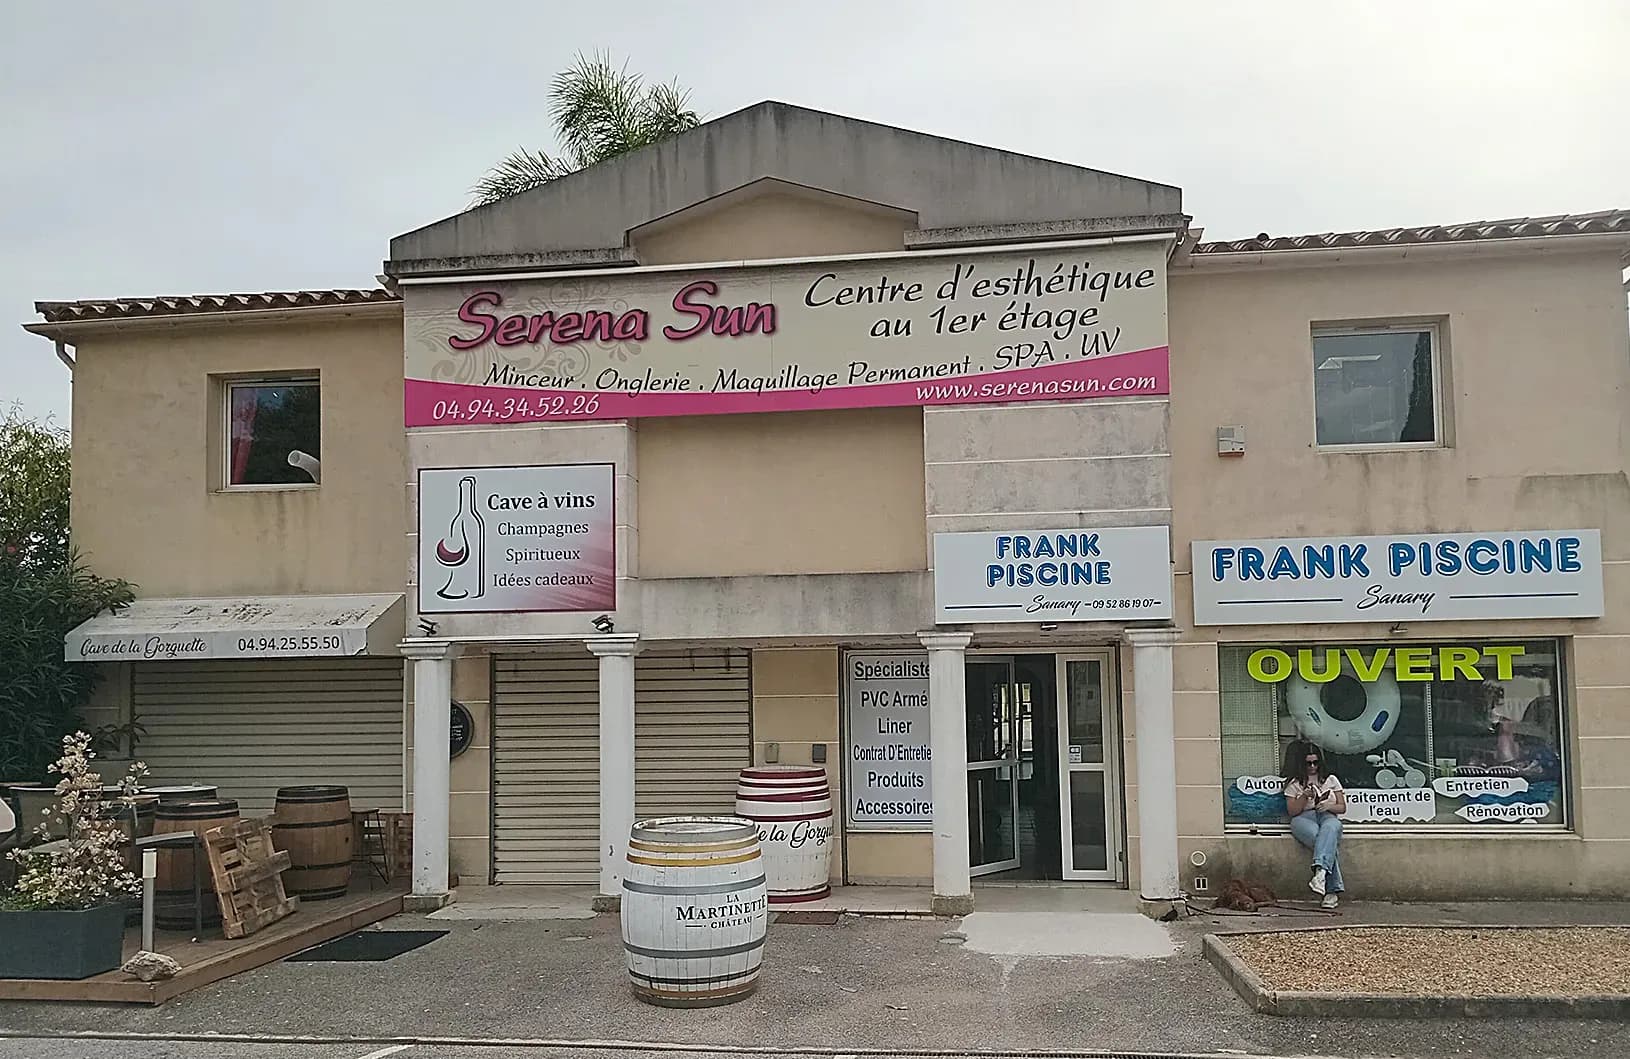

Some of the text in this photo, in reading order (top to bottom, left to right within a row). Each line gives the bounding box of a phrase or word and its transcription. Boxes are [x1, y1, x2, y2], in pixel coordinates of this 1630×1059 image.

[804, 259, 1155, 308] Centre d'esthétique
[448, 281, 777, 350] Serena Sun
[870, 301, 1100, 339] au 1er étage
[483, 363, 575, 389] Minceur
[596, 367, 690, 398] Onglerie
[711, 365, 838, 396] Maquillage
[847, 355, 972, 386] Permanent
[994, 341, 1056, 371] SPA
[1081, 326, 1122, 357] UV
[915, 375, 1157, 401] www.serenasun.com
[432, 395, 600, 420] 04.94.34.52.26
[488, 492, 596, 511] Cave à vins
[498, 522, 589, 538] Champagnes
[996, 533, 1101, 560] FRANK
[506, 549, 581, 565] Spiritueux
[1212, 537, 1582, 582] FRANK PISCINE
[493, 573, 594, 587] Idées cadeaux
[987, 561, 1111, 587] PISCINE
[1026, 594, 1082, 616] Sanary
[1106, 600, 1117, 608] 52
[1119, 600, 1130, 608] 86
[1132, 599, 1141, 608] 19
[1357, 585, 1436, 613] Sanary
[80, 636, 206, 659] Cave de la Gorguette
[238, 636, 339, 652] 04.94.25.55.50
[1247, 646, 1526, 683] OUVERT
[861, 690, 928, 707] PVC Armé
[878, 718, 912, 734] Liner
[853, 744, 932, 761] Contrat D'Entretie
[868, 771, 924, 788] Produits
[1446, 779, 1509, 792] Entretien
[1345, 791, 1431, 803] raitement de
[1369, 805, 1400, 816] l'eau
[1466, 805, 1543, 817] Rénovation
[769, 824, 788, 841] la
[726, 894, 740, 903] LA
